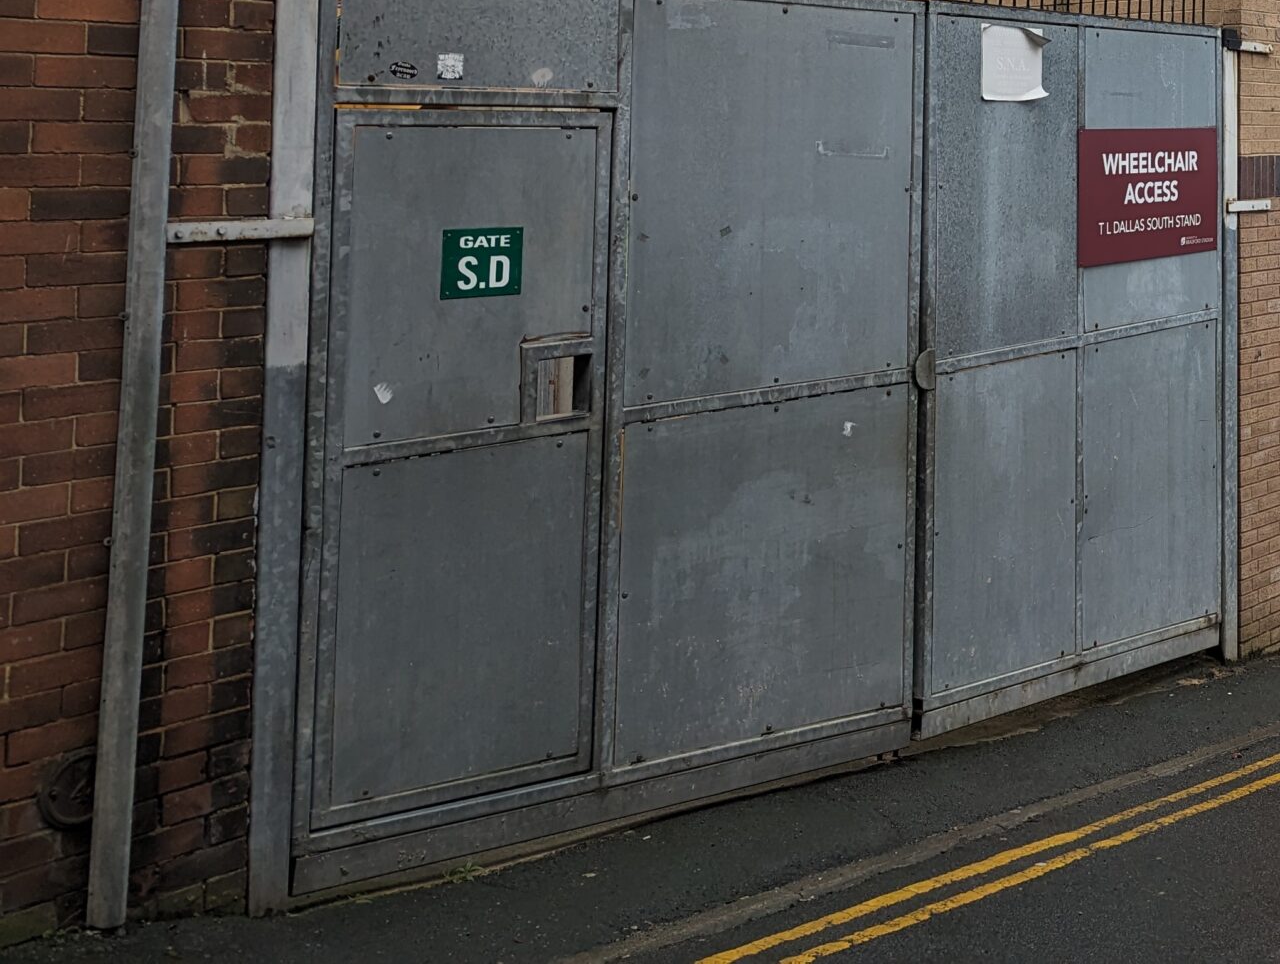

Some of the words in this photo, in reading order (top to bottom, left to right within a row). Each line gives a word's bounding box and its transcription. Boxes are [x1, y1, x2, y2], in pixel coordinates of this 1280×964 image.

[1102, 150, 1198, 175] WHEELCHAIR
[1124, 180, 1178, 204] ACCESS
[1098, 222, 1104, 235] T
[1106, 222, 1112, 234] L
[1114, 218, 1145, 234] DALLAS
[1147, 216, 1174, 231] SOUTH
[1176, 214, 1201, 228] STAND
[460, 235, 511, 248] GATE
[457, 255, 510, 290] S.D
